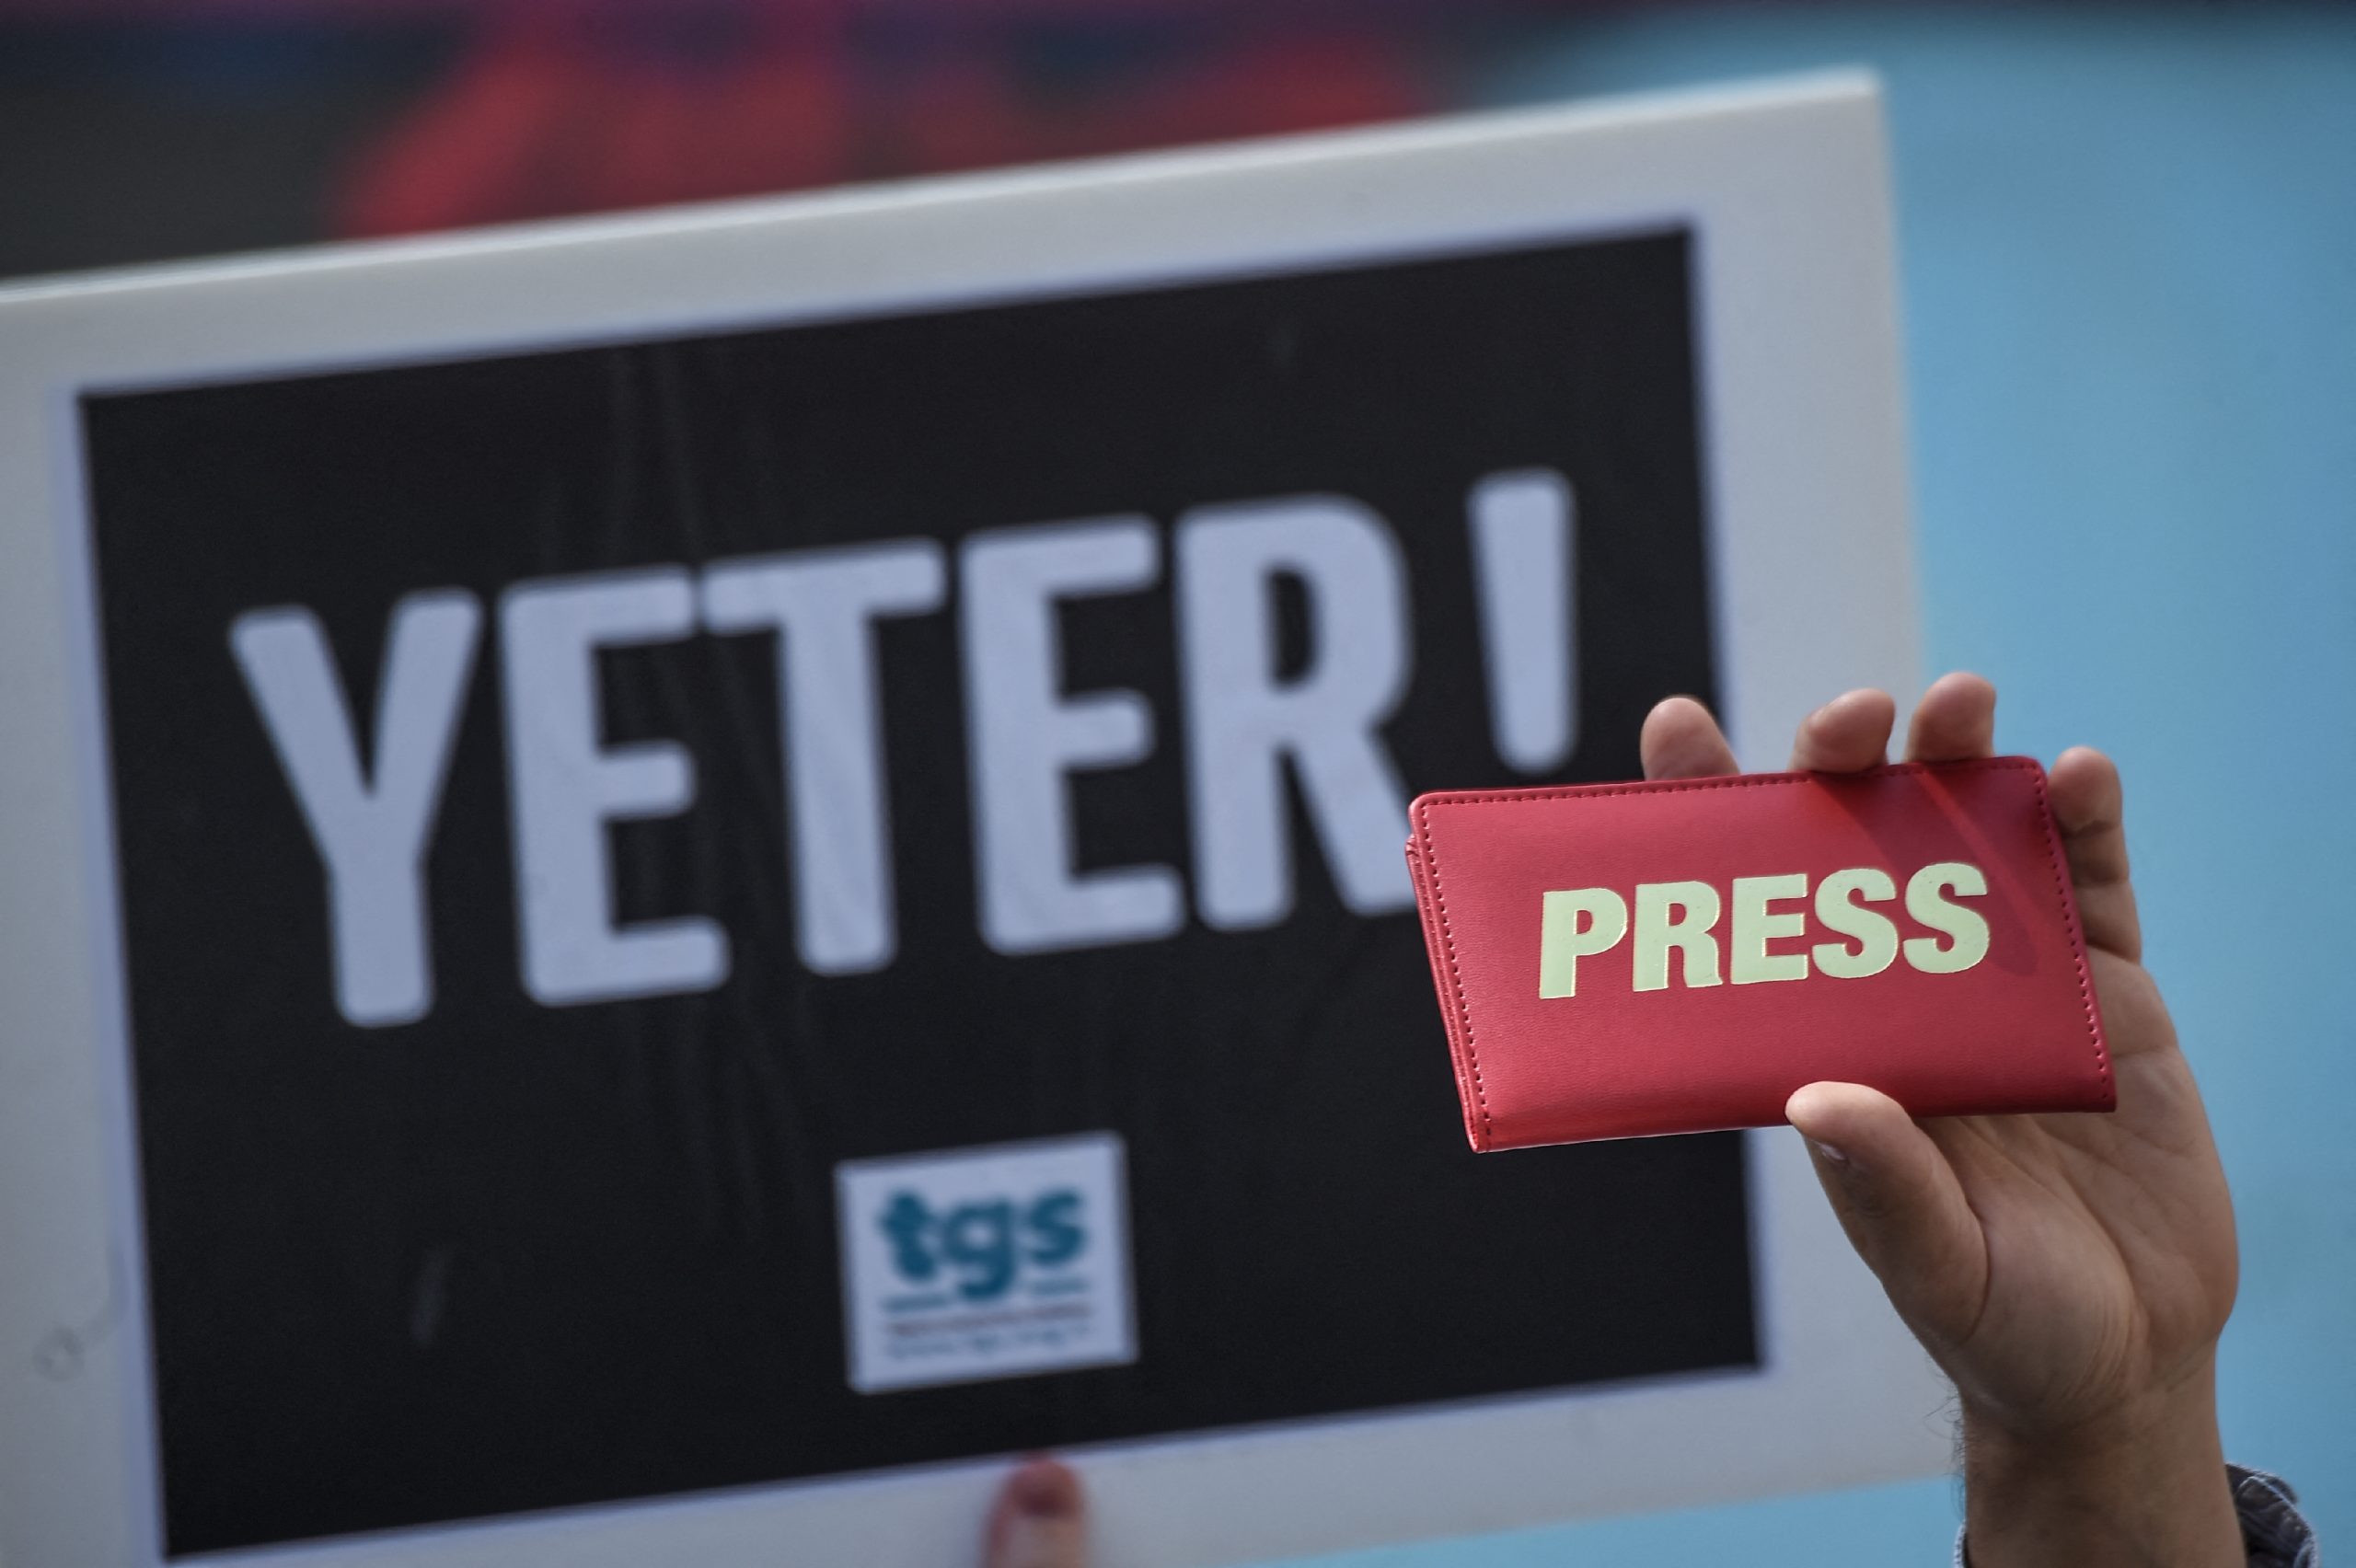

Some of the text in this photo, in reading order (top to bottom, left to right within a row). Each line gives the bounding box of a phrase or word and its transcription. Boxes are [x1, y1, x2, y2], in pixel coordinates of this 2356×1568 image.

[229, 467, 1576, 1027] YETER!
[1539, 861, 1991, 999] PRESS
[879, 1189, 1086, 1301] tgs
